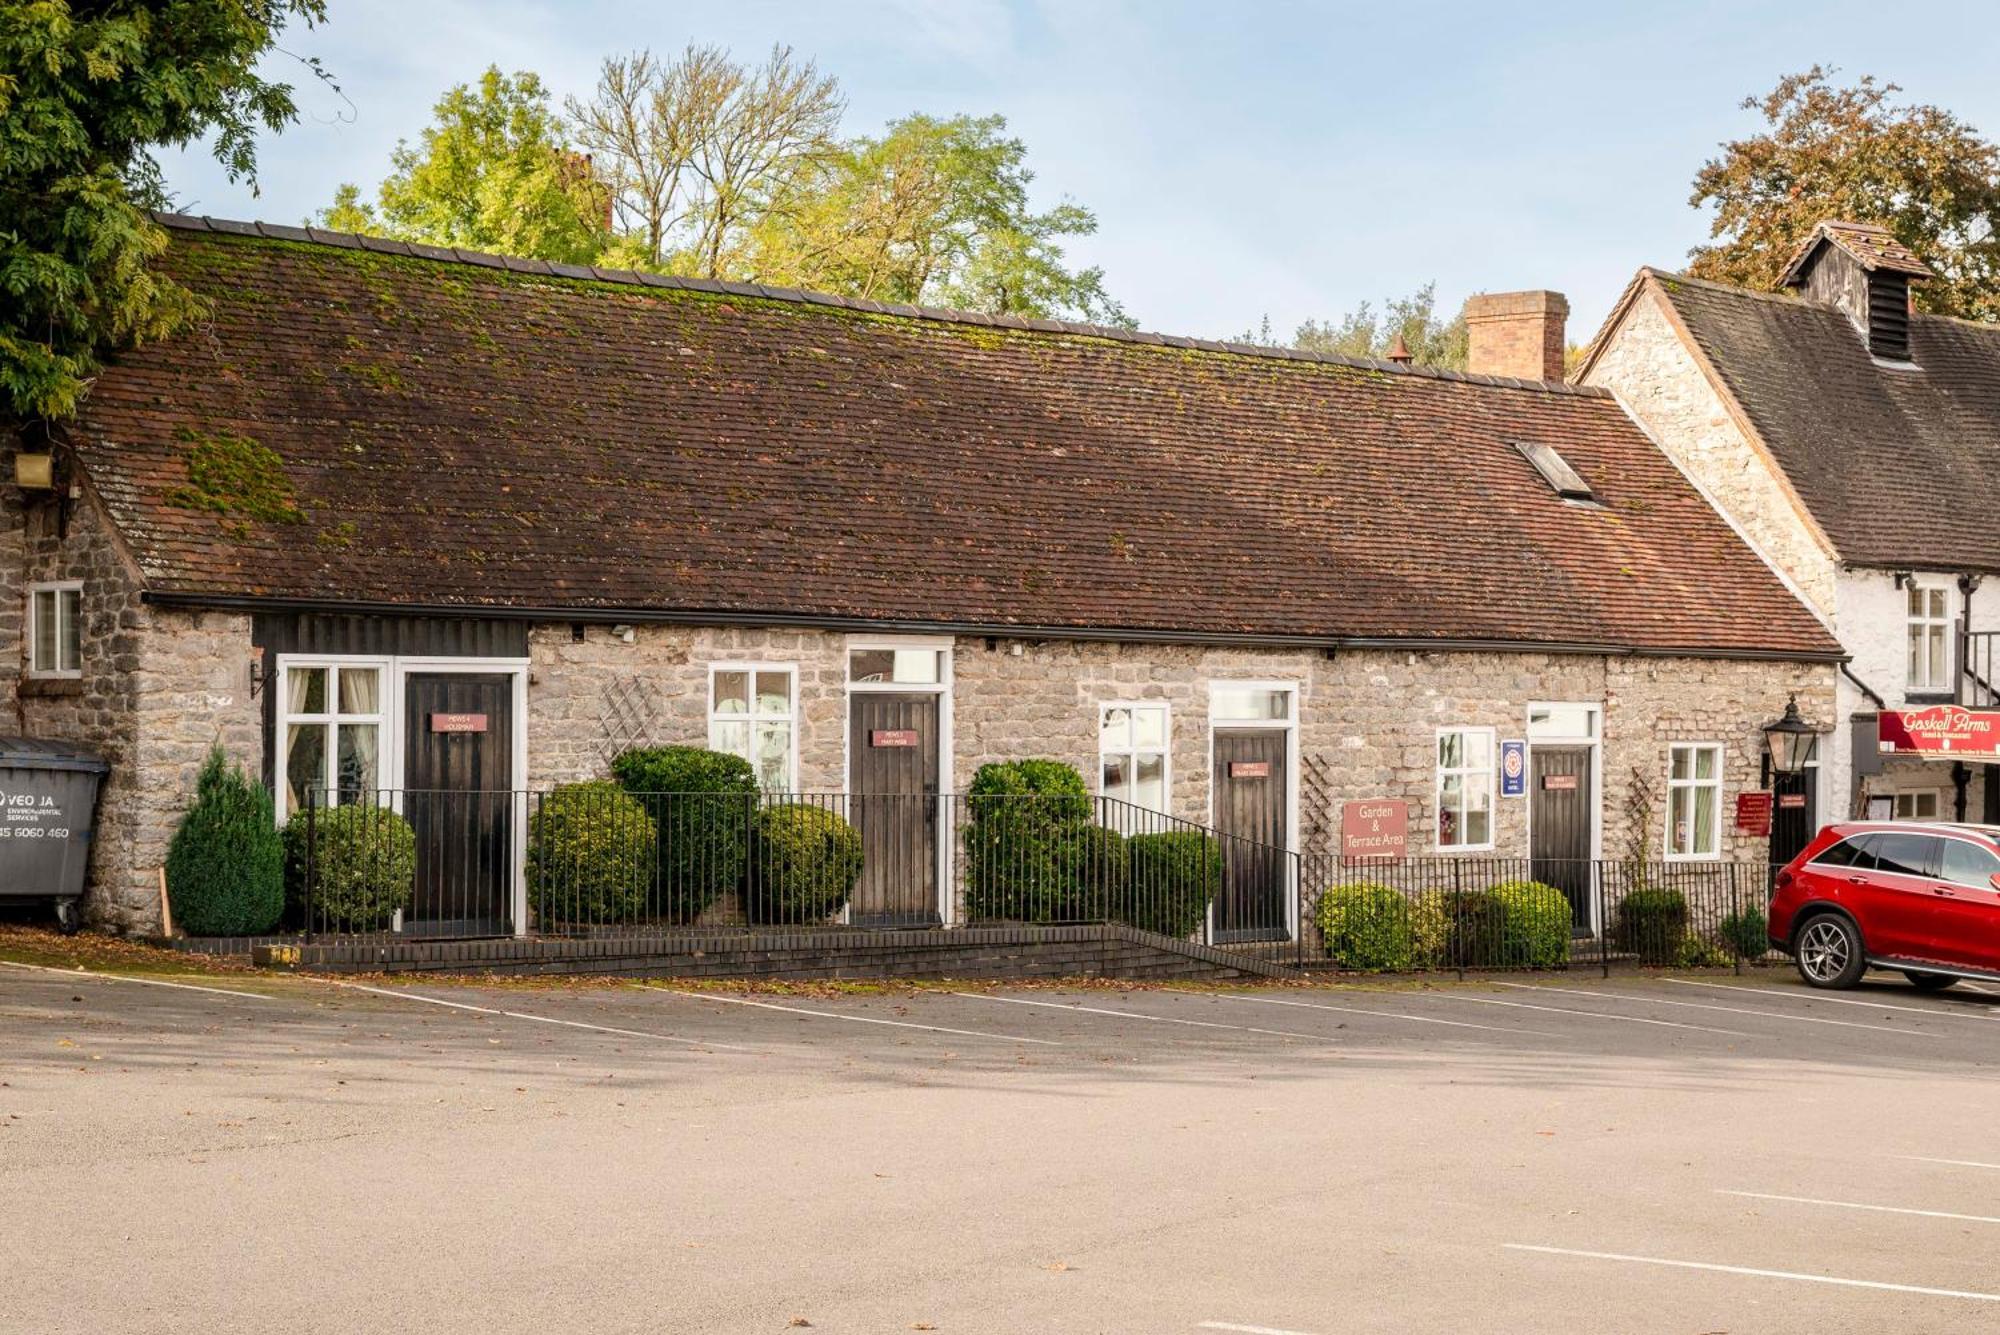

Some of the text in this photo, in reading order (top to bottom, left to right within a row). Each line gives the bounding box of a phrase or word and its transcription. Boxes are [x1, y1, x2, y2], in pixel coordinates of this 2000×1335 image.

[1903, 712, 1991, 733] Gaskell Arms
[1359, 805, 1393, 819] Garden
[14, 827, 45, 838] 6060
[47, 828, 69, 838] 460
[1372, 820, 1380, 832] &
[1346, 833, 1404, 848] Terrace Area
